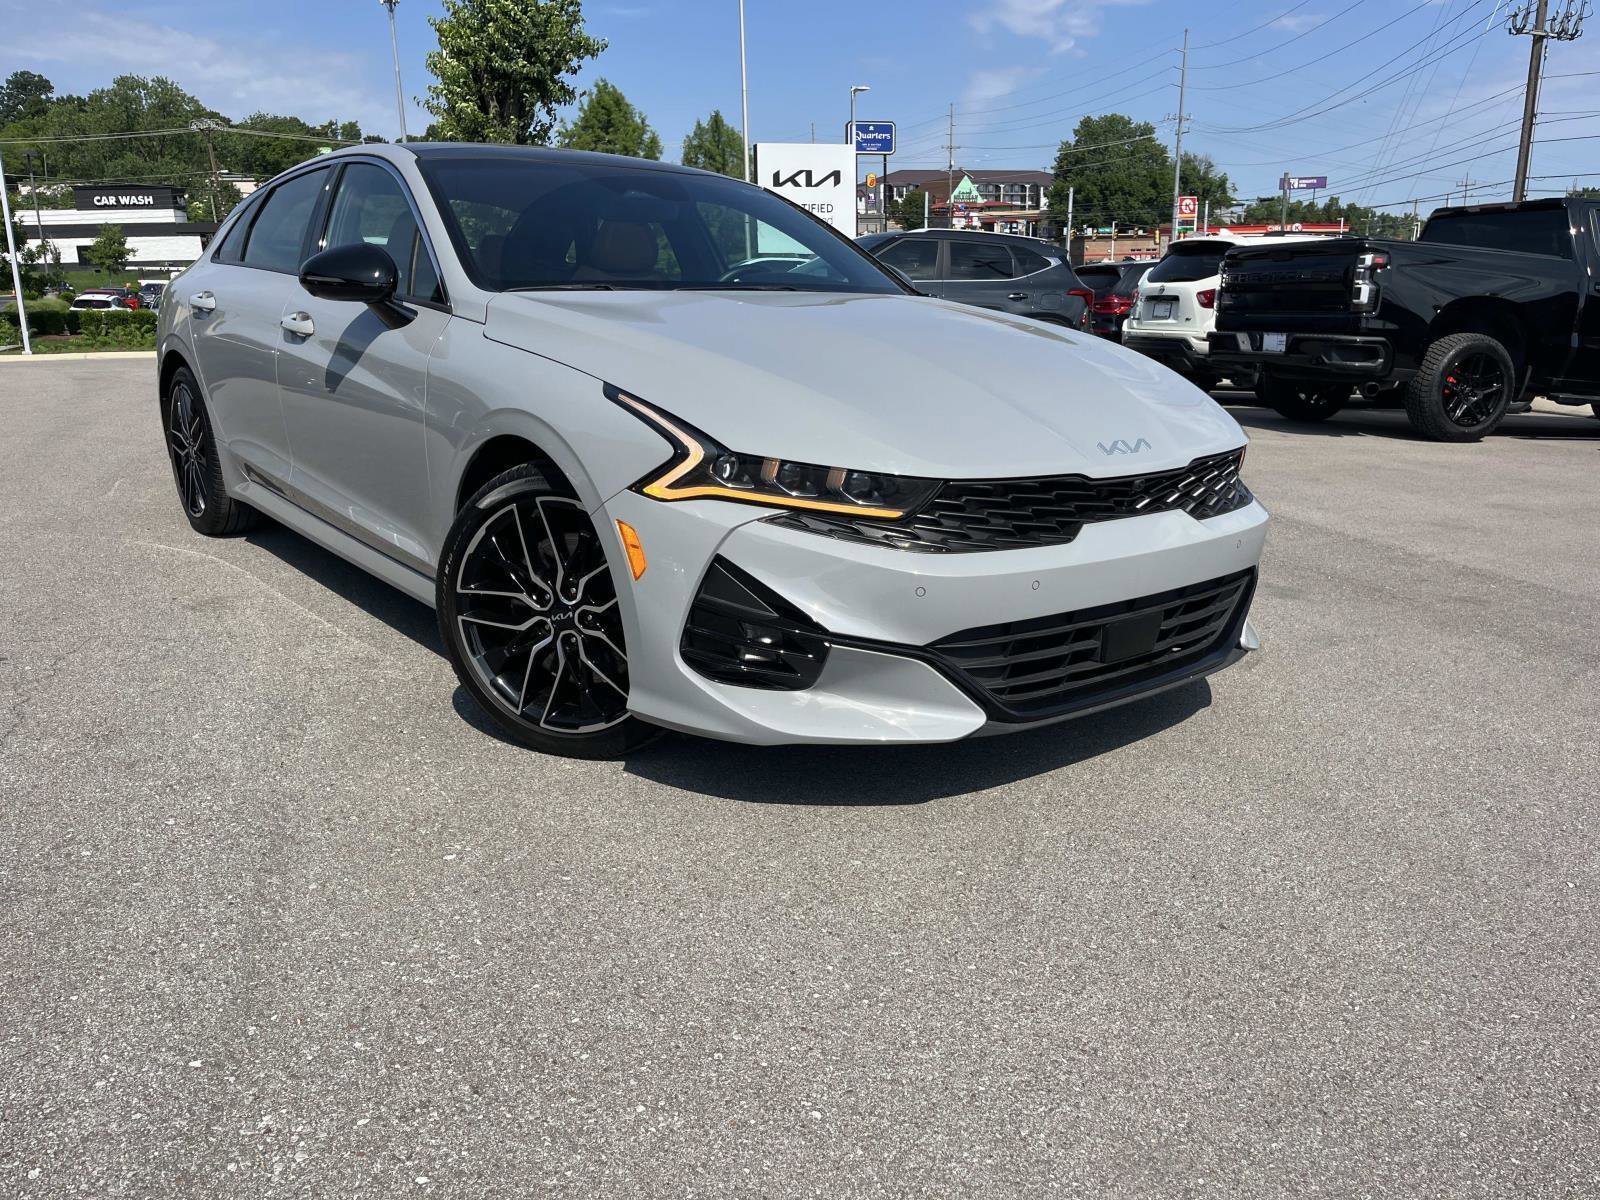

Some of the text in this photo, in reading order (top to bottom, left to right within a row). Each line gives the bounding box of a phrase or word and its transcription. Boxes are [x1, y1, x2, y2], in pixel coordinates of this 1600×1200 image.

[855, 130, 891, 142] Quarters
[772, 169, 841, 188] KIA
[93, 195, 154, 206] CAR WASH
[801, 203, 834, 213] TIFIED
[1096, 438, 1152, 455] KIA
[551, 611, 573, 622] KIA
